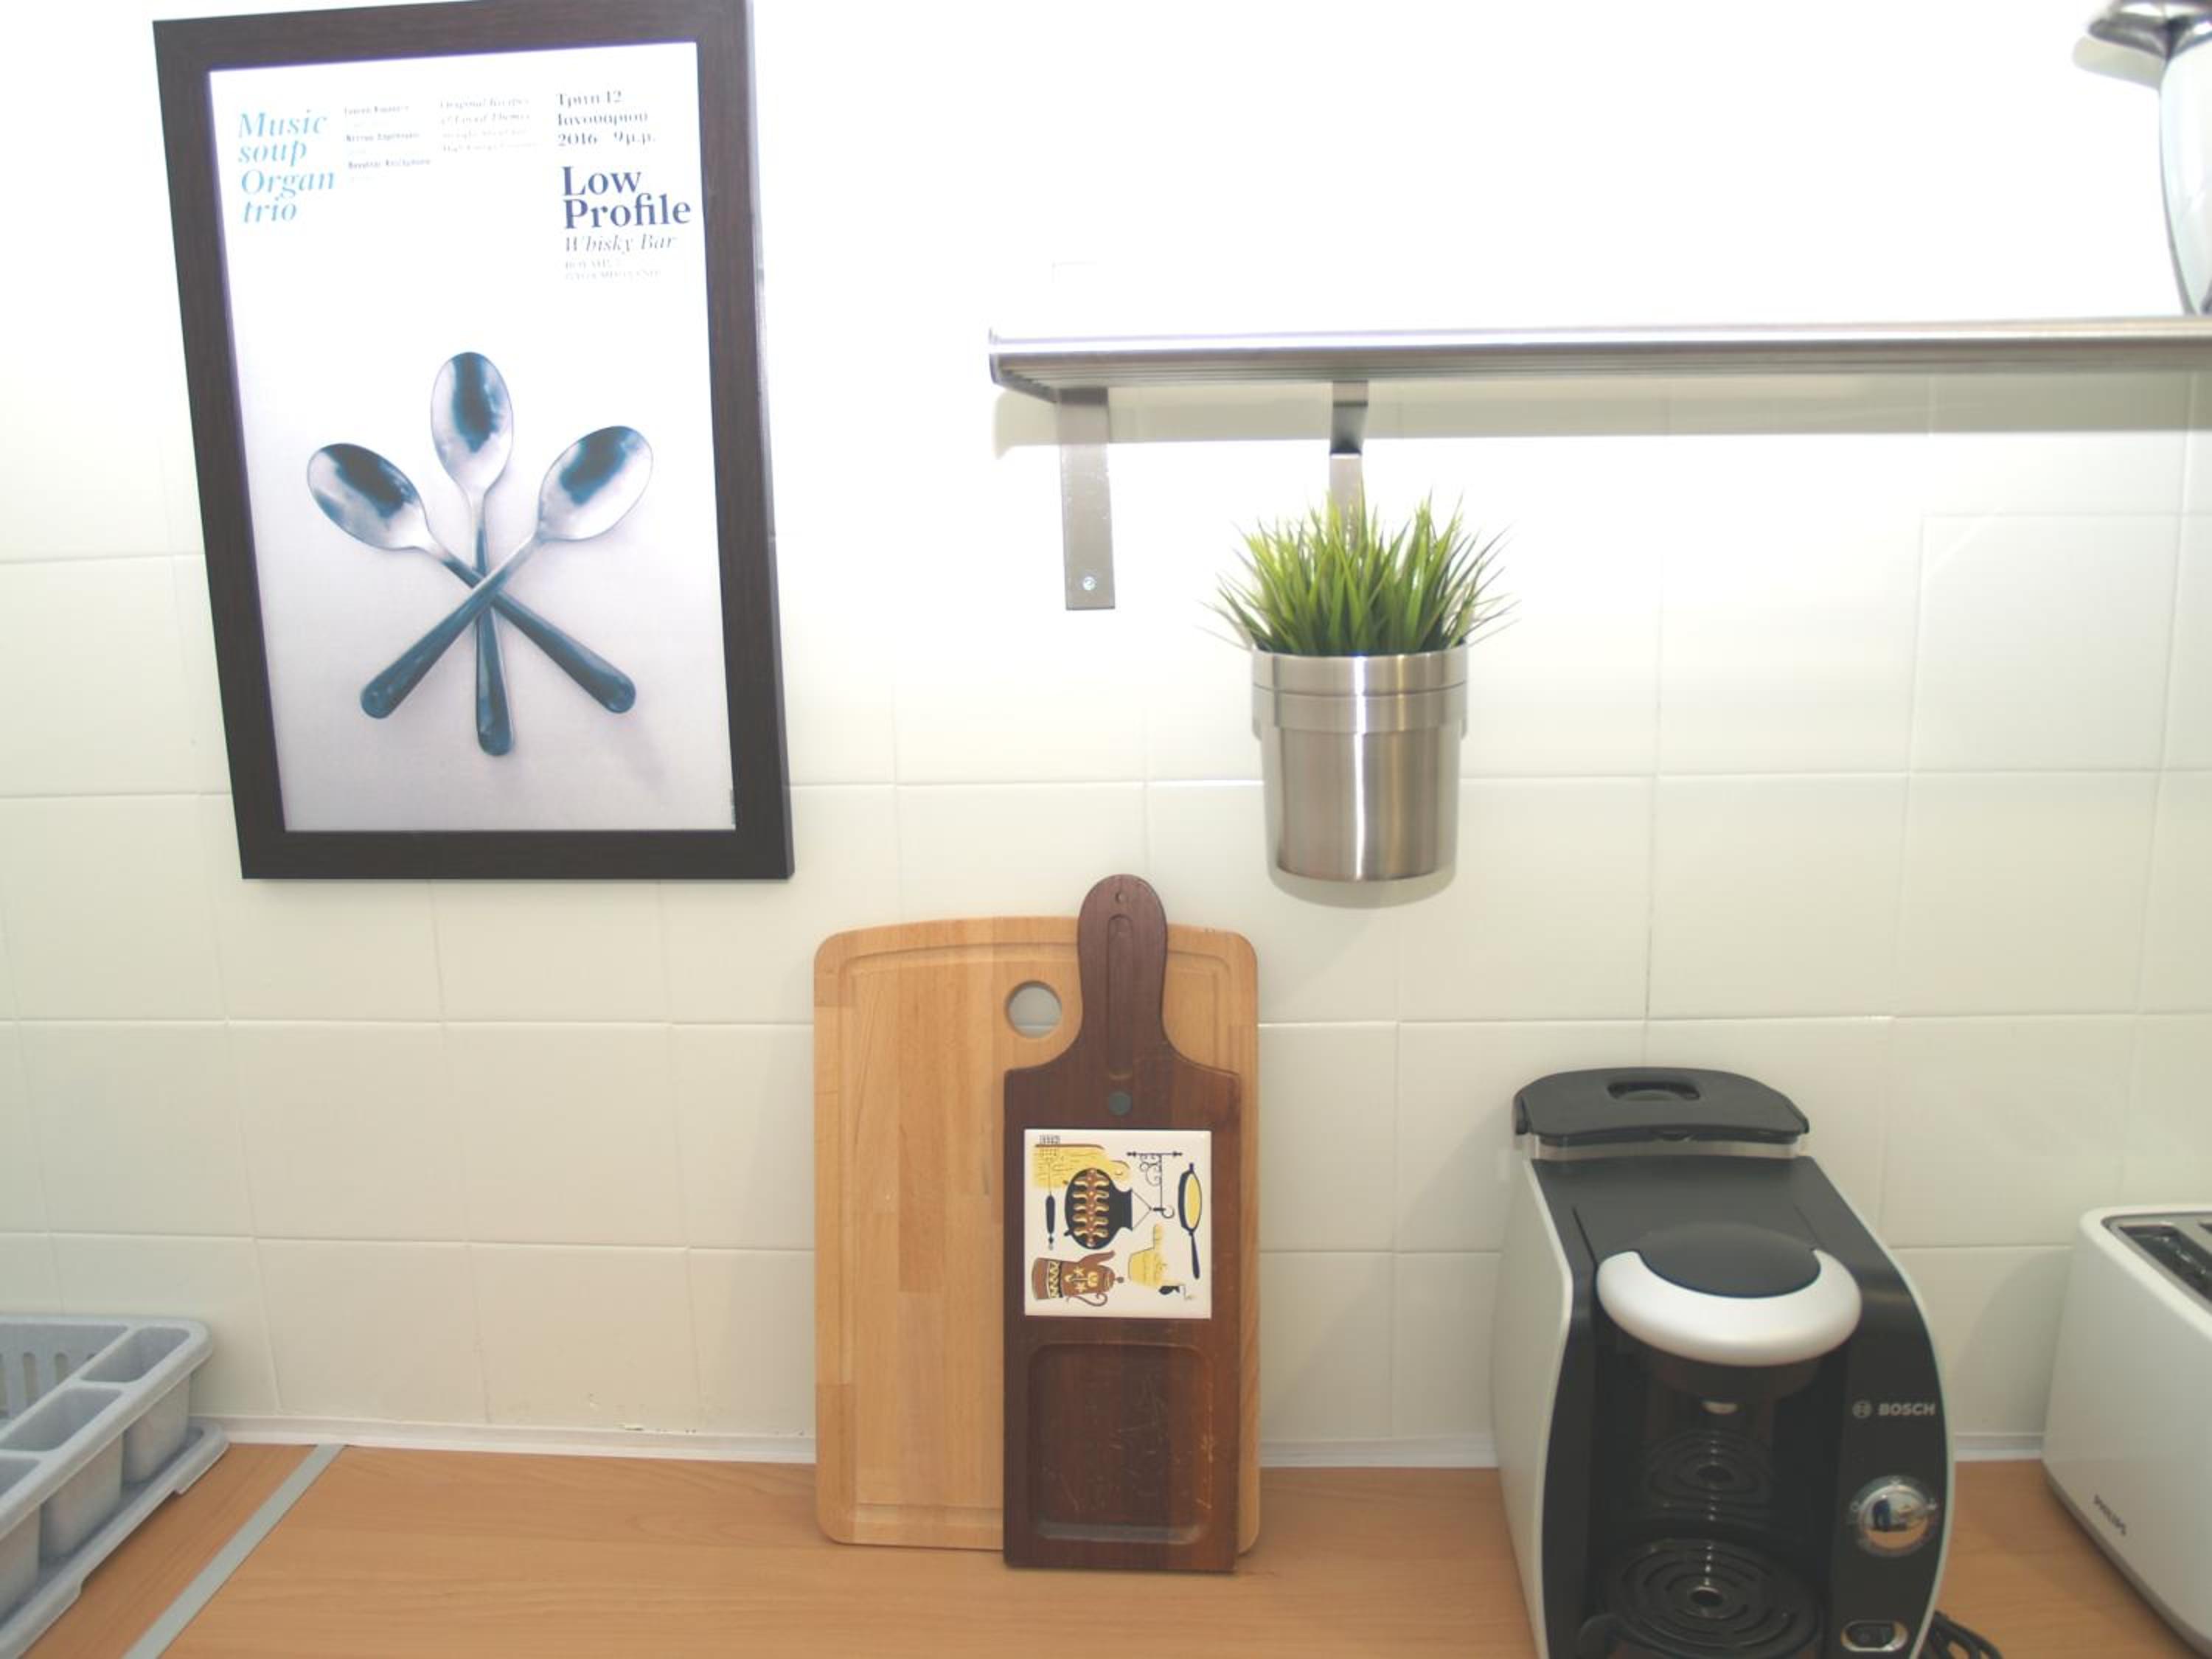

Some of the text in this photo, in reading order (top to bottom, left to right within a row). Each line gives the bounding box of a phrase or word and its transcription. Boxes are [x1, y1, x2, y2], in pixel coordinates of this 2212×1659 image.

[605, 88, 625, 104] 12
[237, 108, 328, 139] Music
[237, 139, 307, 167] soup
[557, 133, 599, 147] 2016
[240, 168, 335, 199] Organ
[562, 165, 642, 196] Low
[243, 198, 297, 223] trio
[563, 192, 692, 229] Profile
[565, 232, 677, 255] Whisky Bar
[1878, 1402, 1935, 1416] BOSCH
